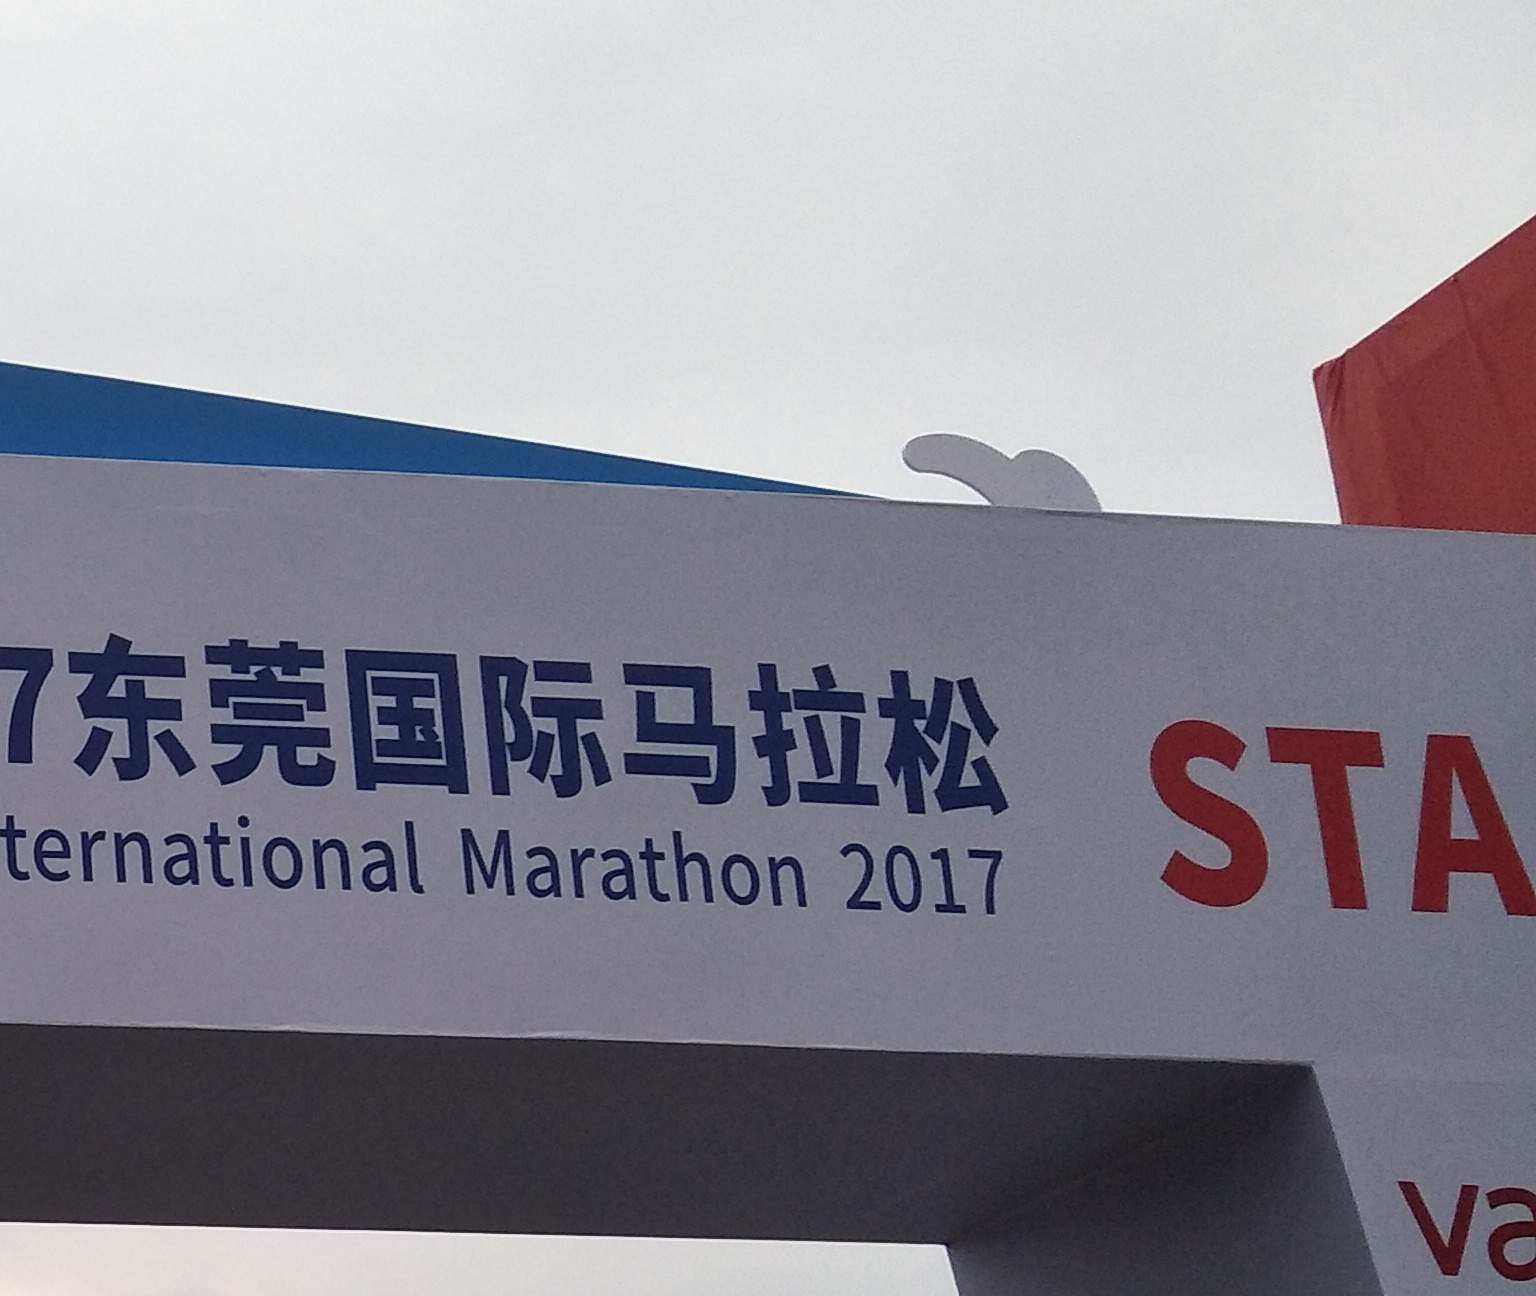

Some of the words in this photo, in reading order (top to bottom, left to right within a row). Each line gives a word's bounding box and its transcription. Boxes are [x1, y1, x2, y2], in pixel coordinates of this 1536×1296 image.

[460, 828, 808, 909] Marathon
[839, 843, 1003, 915] 2017
[1149, 719, 1536, 917] STA
